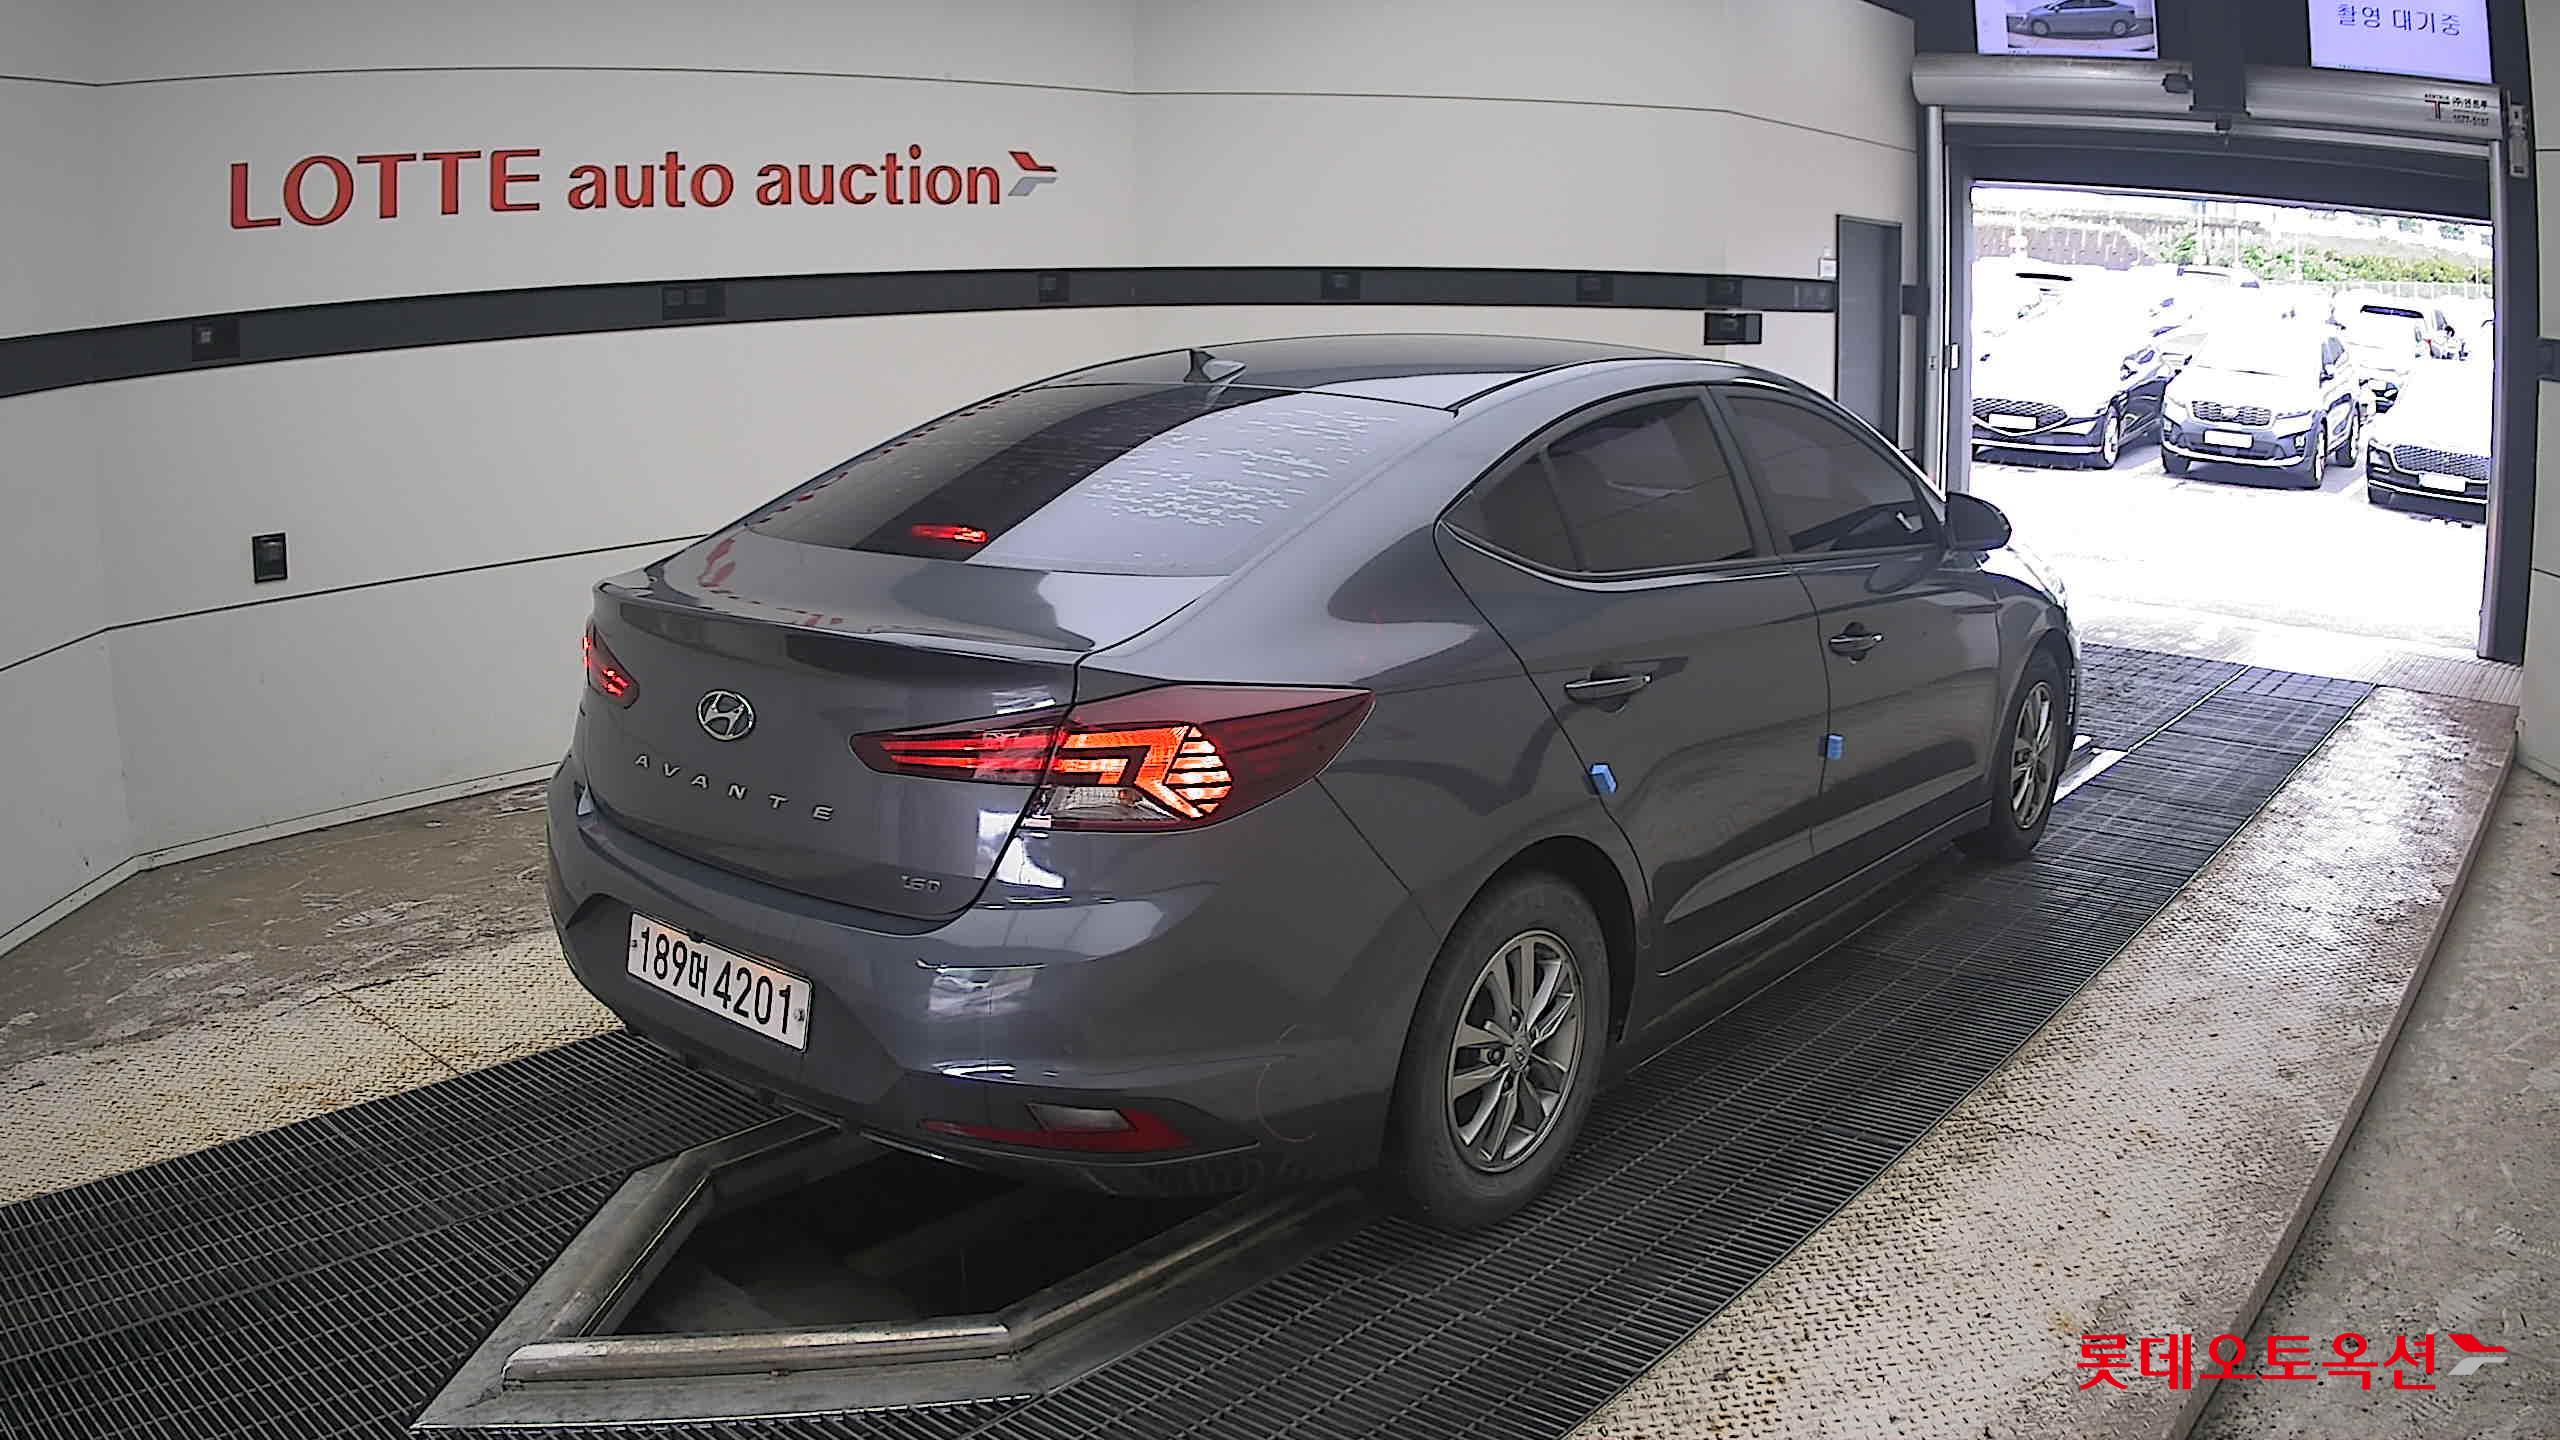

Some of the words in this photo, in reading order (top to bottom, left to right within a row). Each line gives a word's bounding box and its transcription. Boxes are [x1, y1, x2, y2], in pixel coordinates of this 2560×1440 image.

[2392, 9, 2461, 37] 대기중
[229, 148, 541, 230] LOTTE
[567, 150, 736, 210] auto
[755, 144, 1001, 206] auction
[634, 753, 834, 821] AVANTE
